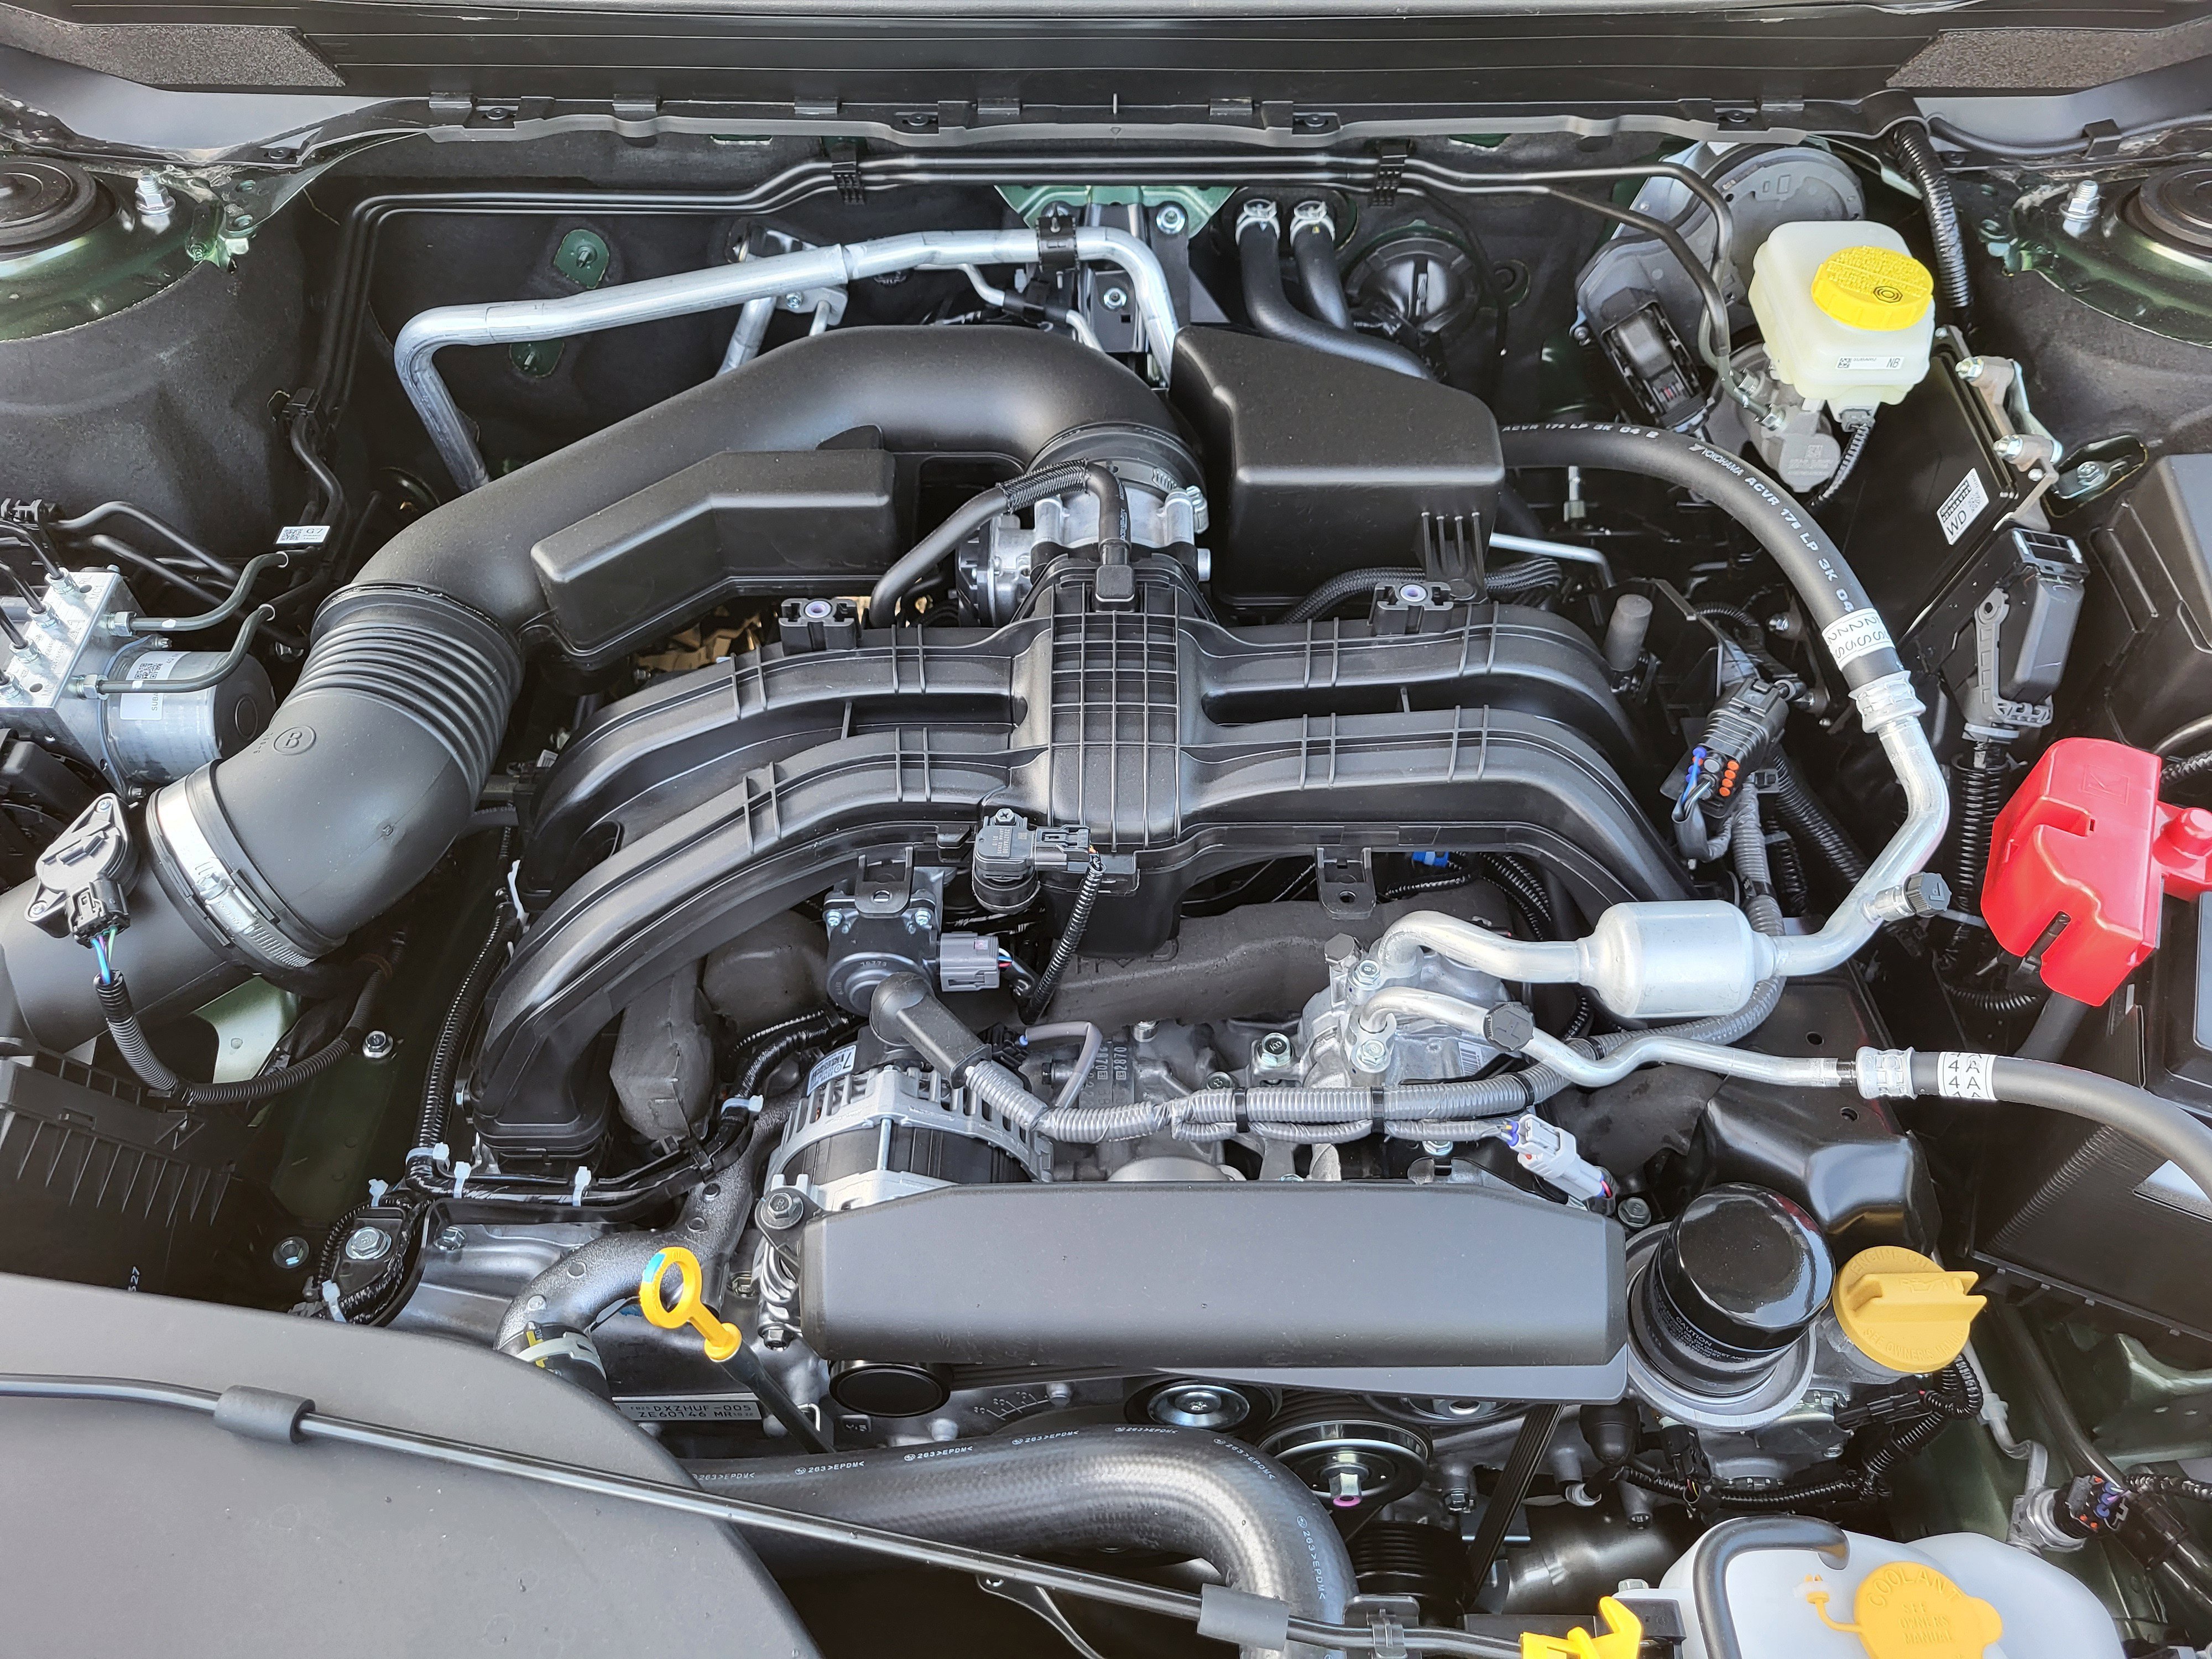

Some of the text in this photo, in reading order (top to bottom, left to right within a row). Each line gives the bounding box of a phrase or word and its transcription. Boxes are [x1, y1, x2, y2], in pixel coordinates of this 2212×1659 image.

[1886, 358, 1901, 368] NB
[1619, 426, 1641, 435] 04
[1701, 447, 1745, 477] YOKOHAMA
[1744, 477, 1780, 506] ACVR
[1799, 532, 1819, 551] LP
[1818, 558, 1838, 582] 3K
[1946, 510, 1967, 536] WD
[283, 732, 303, 749] B
[1113, 1047, 1128, 1070] 2870
[1676, 1316, 1713, 1347] CAUTION
[1864, 1328, 1885, 1345] SEE
[1703, 1344, 1730, 1358] GASKET
[1867, 1567, 1963, 1607] COOLANT
[1902, 1601, 1927, 1613] SEE
[1898, 1615, 1950, 1629] OWNERS
[1902, 1630, 1953, 1644] MANUAL
